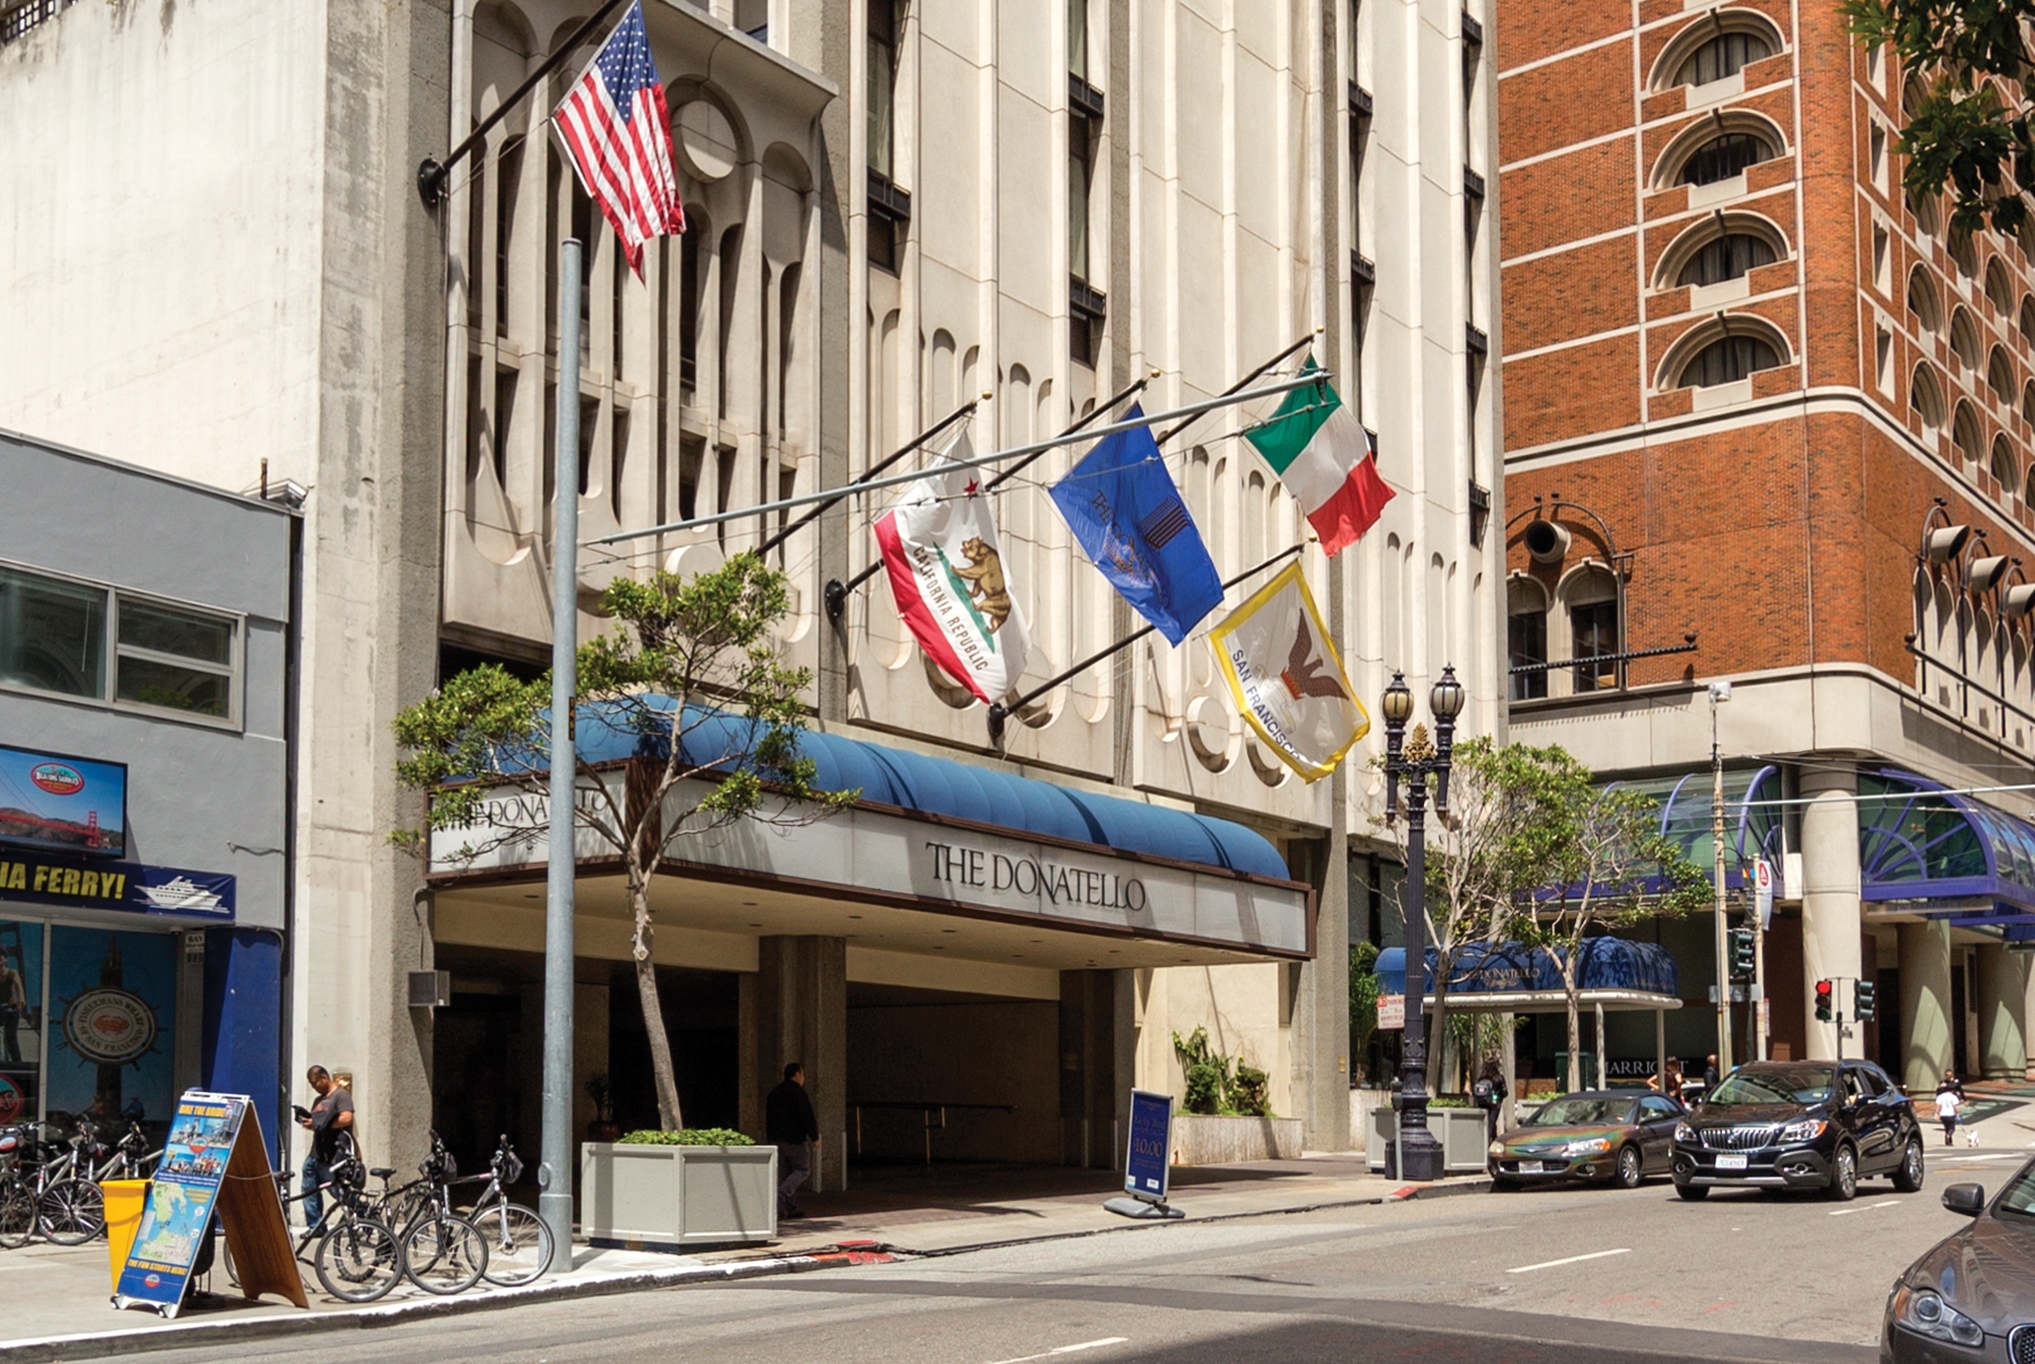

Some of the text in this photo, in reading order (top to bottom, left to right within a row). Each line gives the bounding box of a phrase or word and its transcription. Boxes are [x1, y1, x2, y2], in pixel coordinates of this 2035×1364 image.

[913, 546, 989, 671] CALIFORNIA REPUBLIC
[1232, 649, 1301, 760] SAN FRANCISCO
[33, 865, 127, 899] FERRY!
[925, 842, 1147, 912] THE DONATELLO
